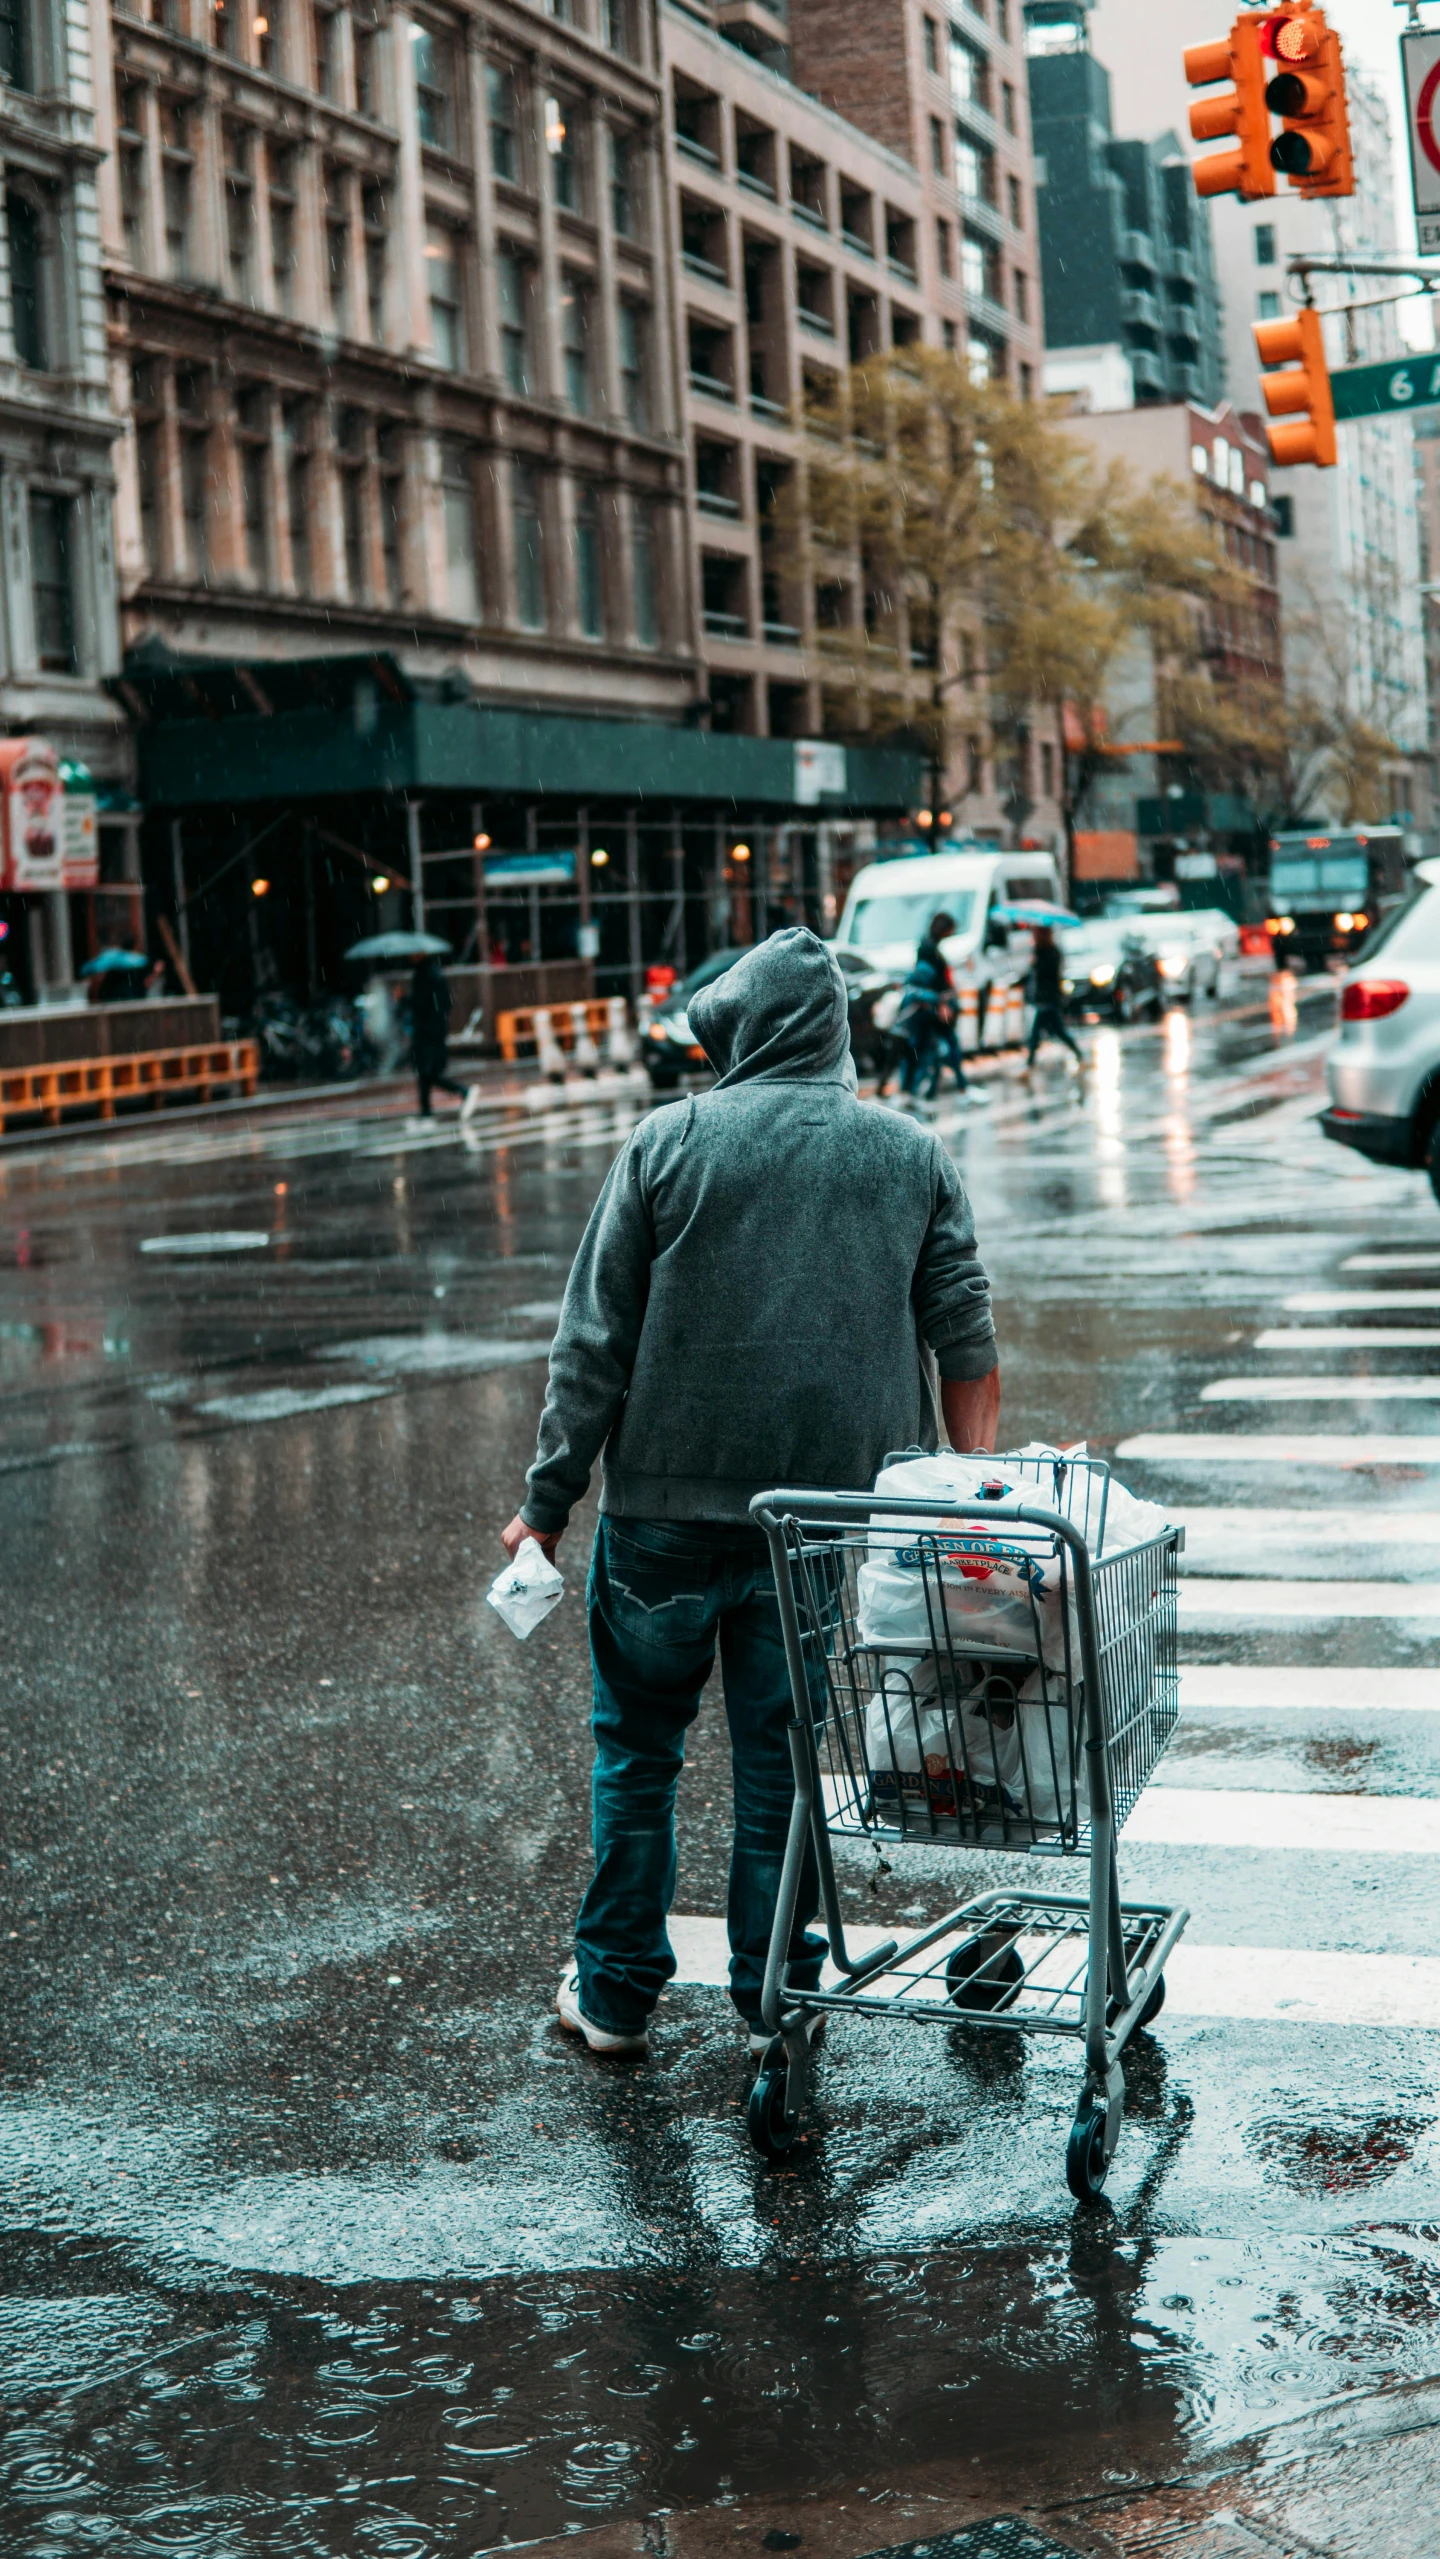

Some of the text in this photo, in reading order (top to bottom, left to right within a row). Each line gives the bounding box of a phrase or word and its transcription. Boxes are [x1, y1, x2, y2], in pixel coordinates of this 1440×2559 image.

[1389, 370, 1415, 402] 6
[971, 1542, 996, 1555] OF
[1002, 1546, 1040, 1579] EDN
[976, 1587, 1006, 1596] EVERY
[1008, 1590, 1031, 1599] AISL
